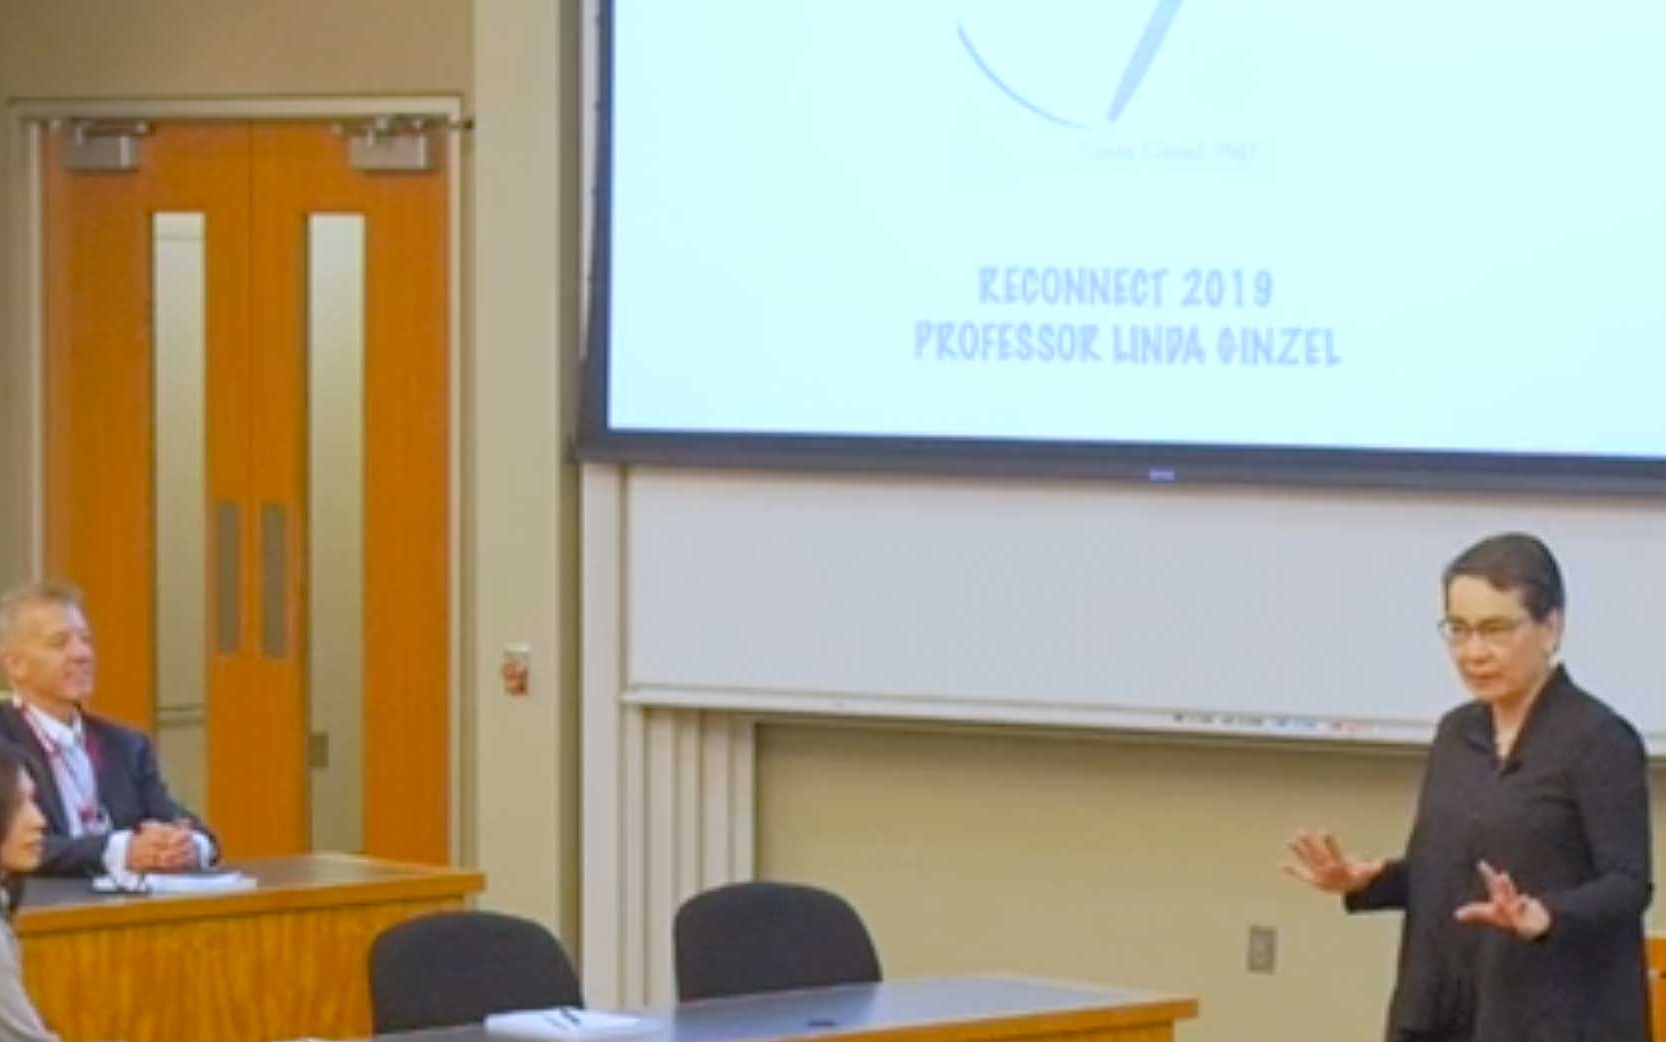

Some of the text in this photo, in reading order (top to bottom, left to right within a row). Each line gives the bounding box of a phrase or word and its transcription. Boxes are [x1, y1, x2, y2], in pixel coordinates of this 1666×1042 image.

[978, 266, 1274, 308] RECONNECT 2019
[914, 321, 1342, 368] PROFESSOR LINDA GINZEL
